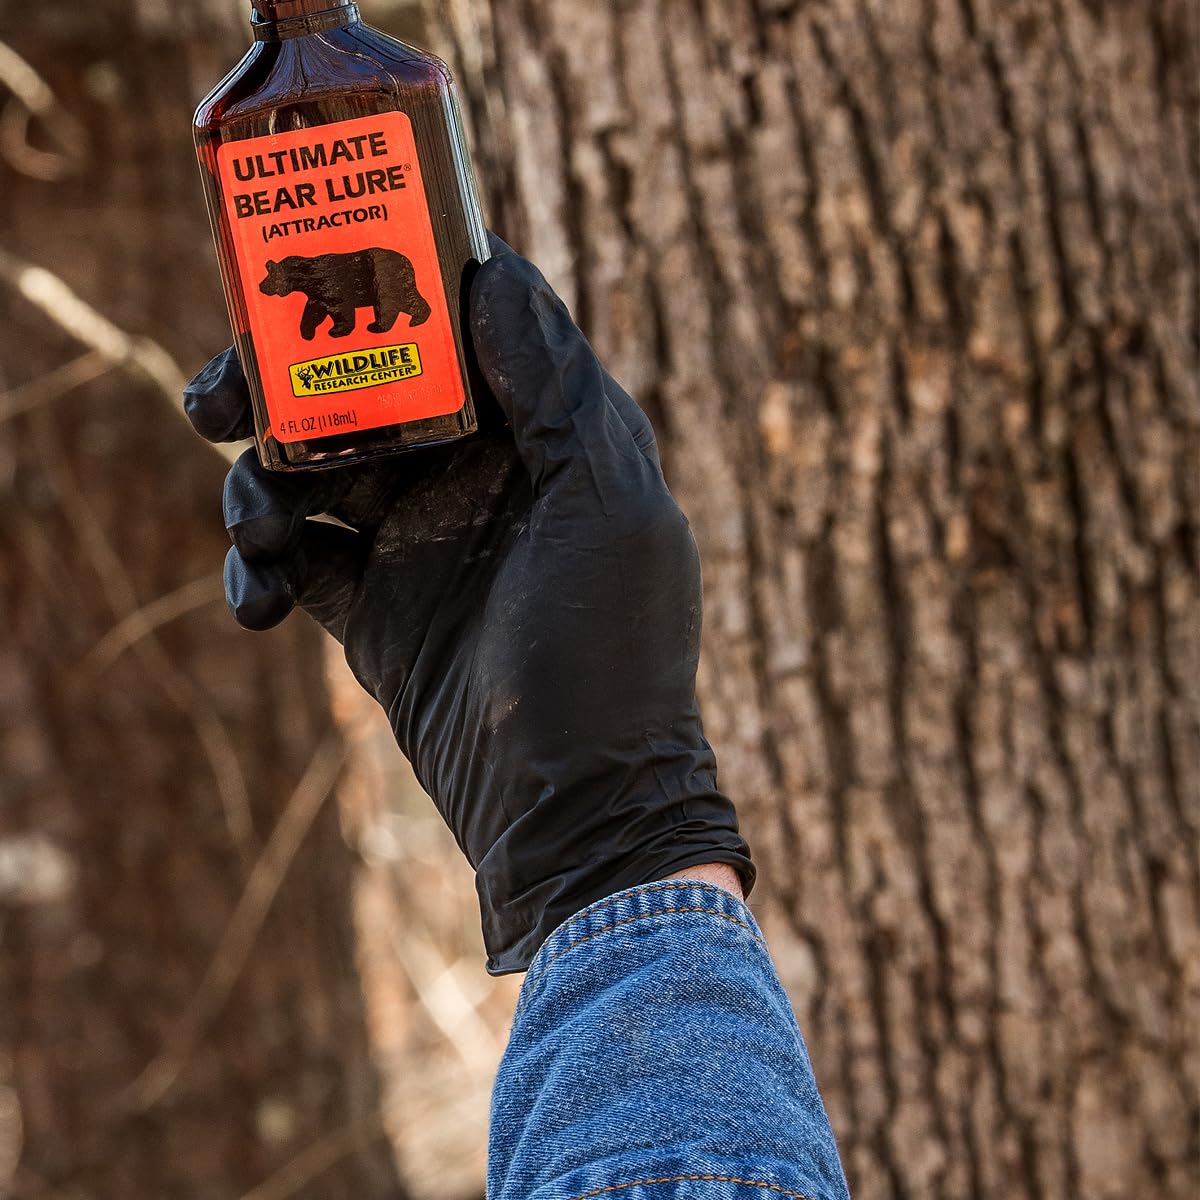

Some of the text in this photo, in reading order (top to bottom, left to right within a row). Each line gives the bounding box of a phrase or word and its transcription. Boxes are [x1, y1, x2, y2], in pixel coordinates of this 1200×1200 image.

[232, 131, 388, 182] ULTIMATE
[233, 182, 316, 219] BEAR
[262, 204, 388, 243] (ATTRACTOR)
[310, 347, 412, 378] WILDLIFE
[314, 375, 369, 392] RESEARCH
[280, 409, 358, 434] 4 FL OZ (118mL)
